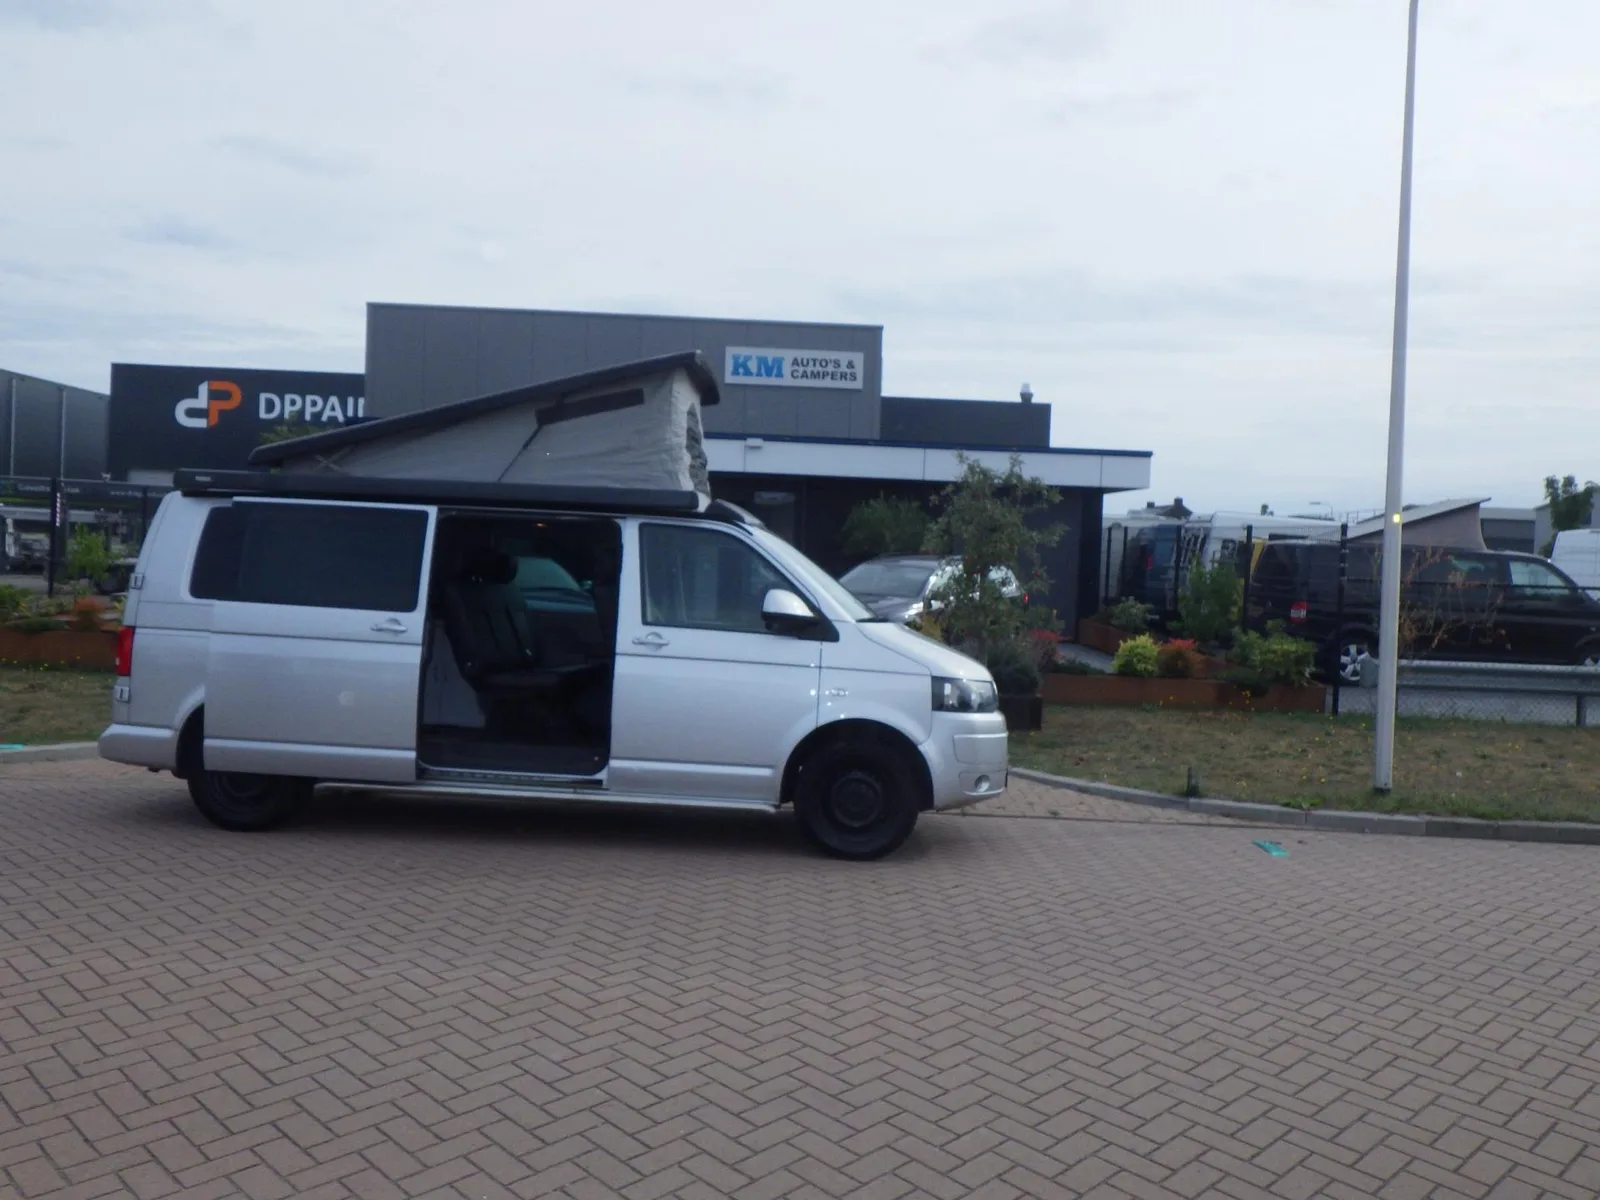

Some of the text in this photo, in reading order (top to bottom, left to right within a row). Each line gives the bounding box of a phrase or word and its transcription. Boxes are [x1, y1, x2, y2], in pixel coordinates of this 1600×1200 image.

[731, 353, 785, 379] KM
[791, 356, 856, 370] AUTO'S &
[790, 368, 857, 382] CAMPERS
